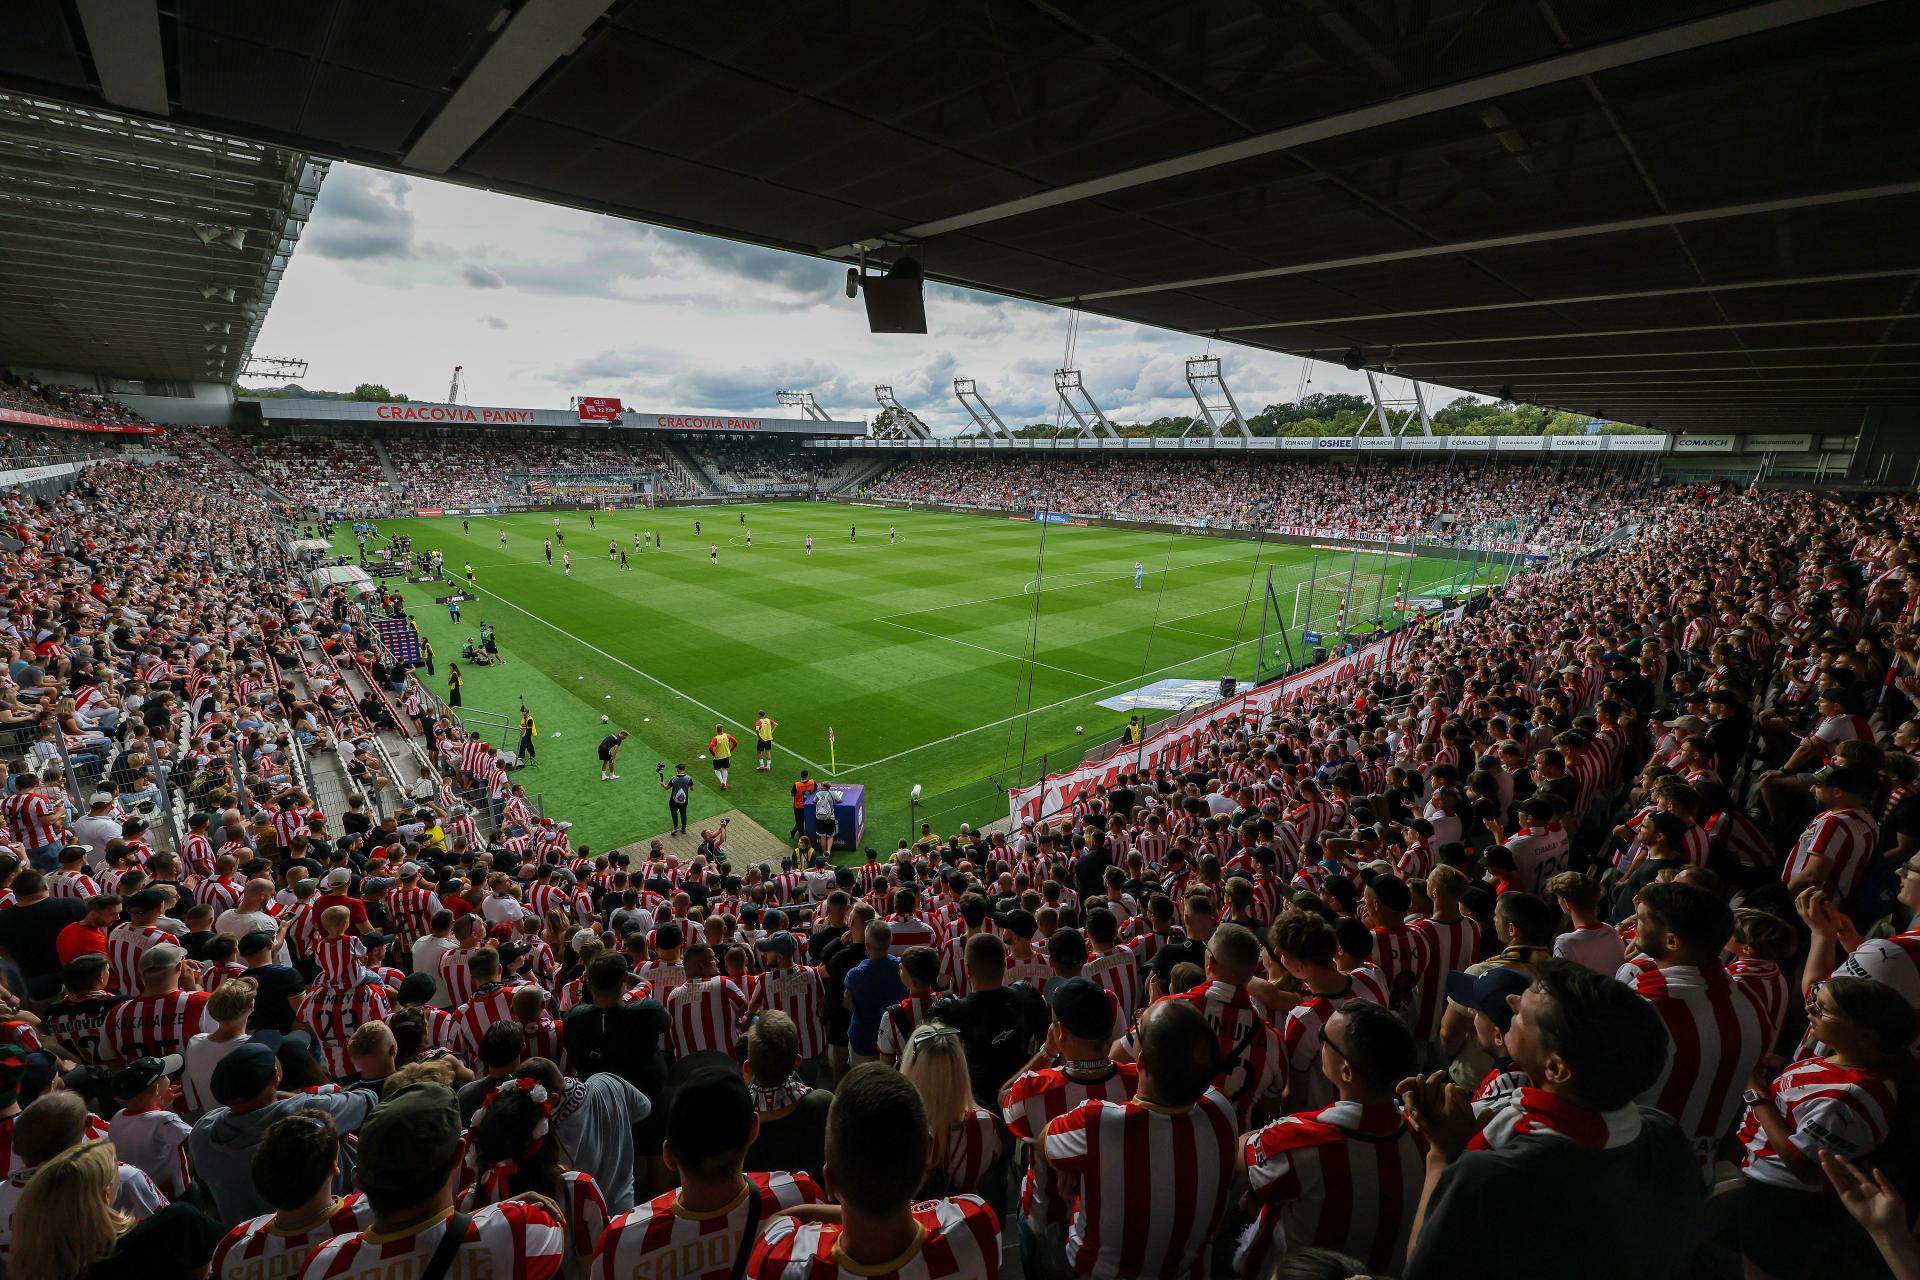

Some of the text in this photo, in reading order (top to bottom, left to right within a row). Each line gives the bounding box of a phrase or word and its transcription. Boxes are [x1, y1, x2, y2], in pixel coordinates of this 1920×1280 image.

[376, 406, 535, 423] CRACOVIA PANY!
[657, 416, 762, 430] CRACOVIA PANY!
[1319, 439, 1352, 448] OSHEE
[1556, 439, 1598, 447] COMARCH
[1678, 439, 1729, 447] COMARCH
